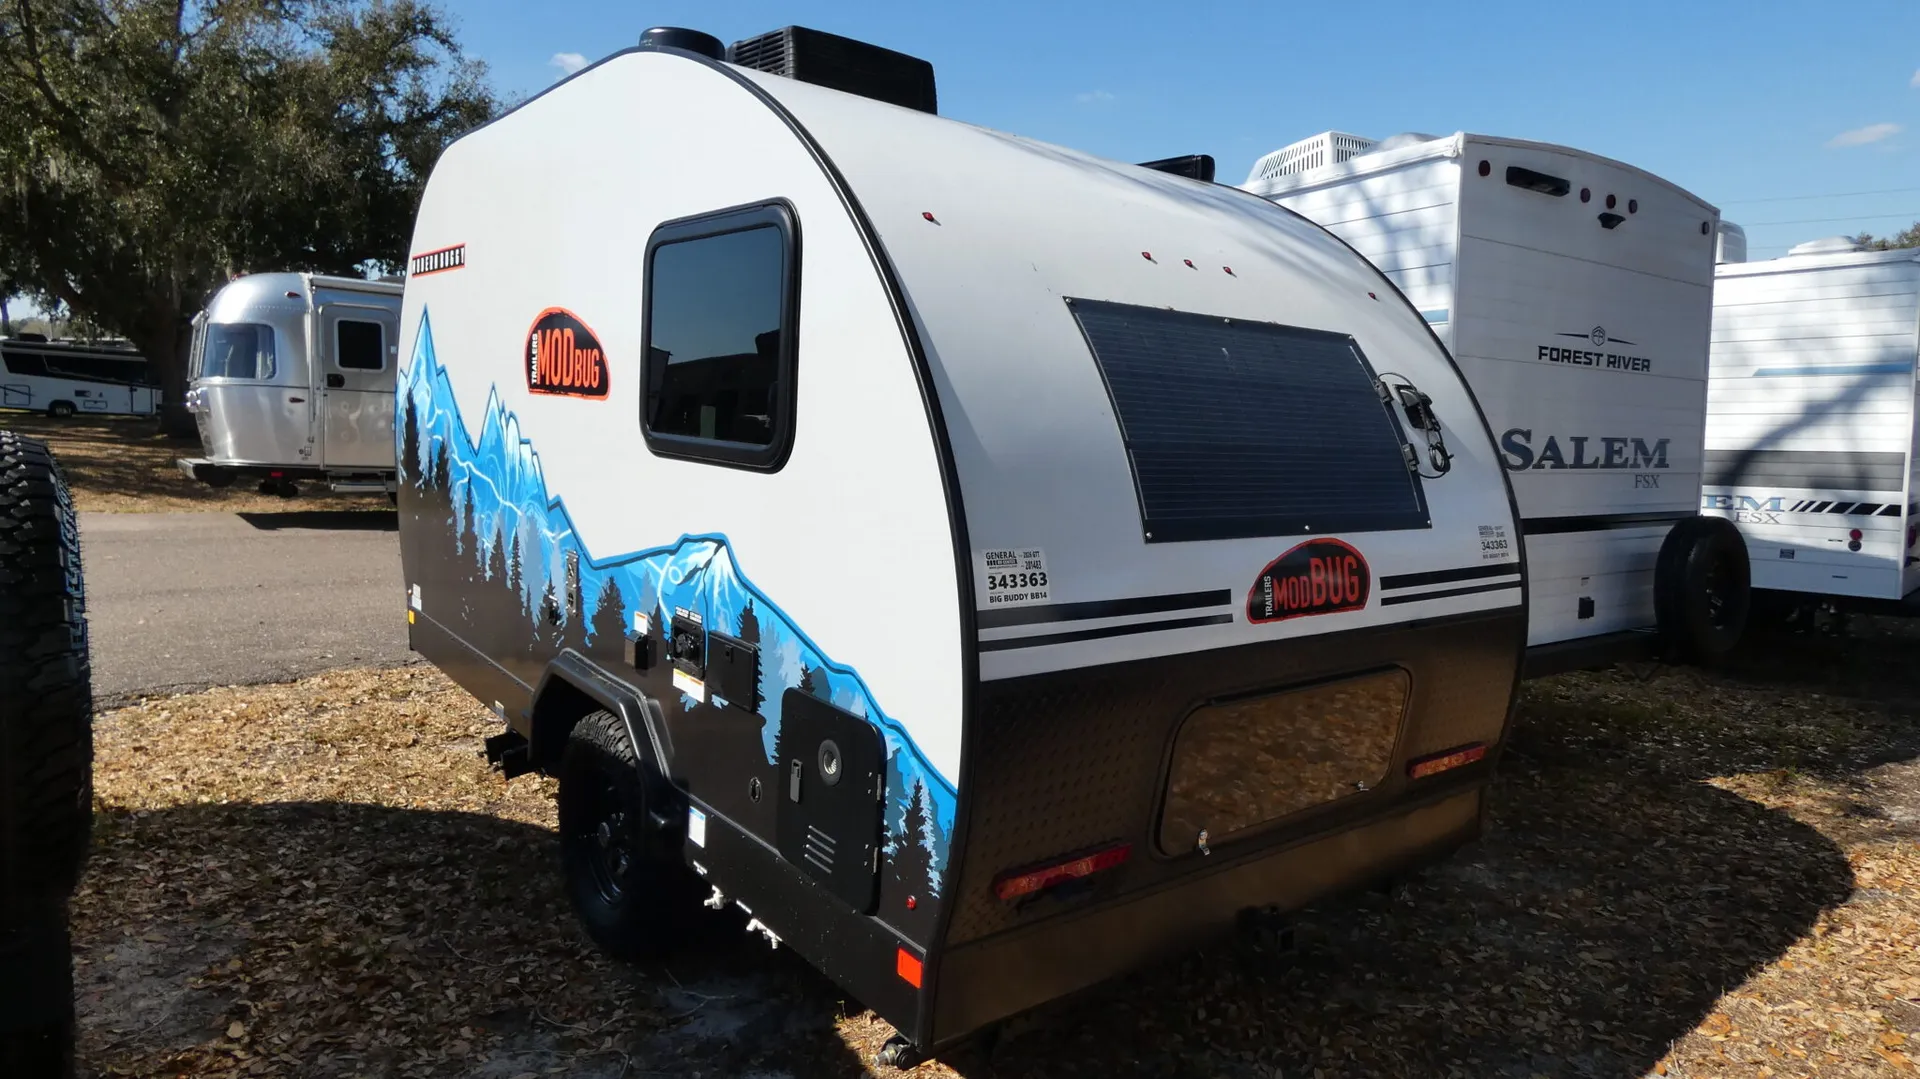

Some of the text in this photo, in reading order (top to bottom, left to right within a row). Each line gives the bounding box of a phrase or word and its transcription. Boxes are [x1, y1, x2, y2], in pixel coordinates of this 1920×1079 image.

[1538, 346, 1651, 372] FOREST RIVER
[1500, 428, 1670, 472] SALEM
[1635, 474, 1660, 489] FSX
[1736, 511, 1781, 525] FSX
[1481, 540, 1508, 550] 343363
[985, 551, 1017, 560] GENERAL
[988, 571, 1048, 590] 343363
[990, 592, 1047, 604] BIG BUDDY BB14
[1263, 575, 1273, 617] TRAILERS
